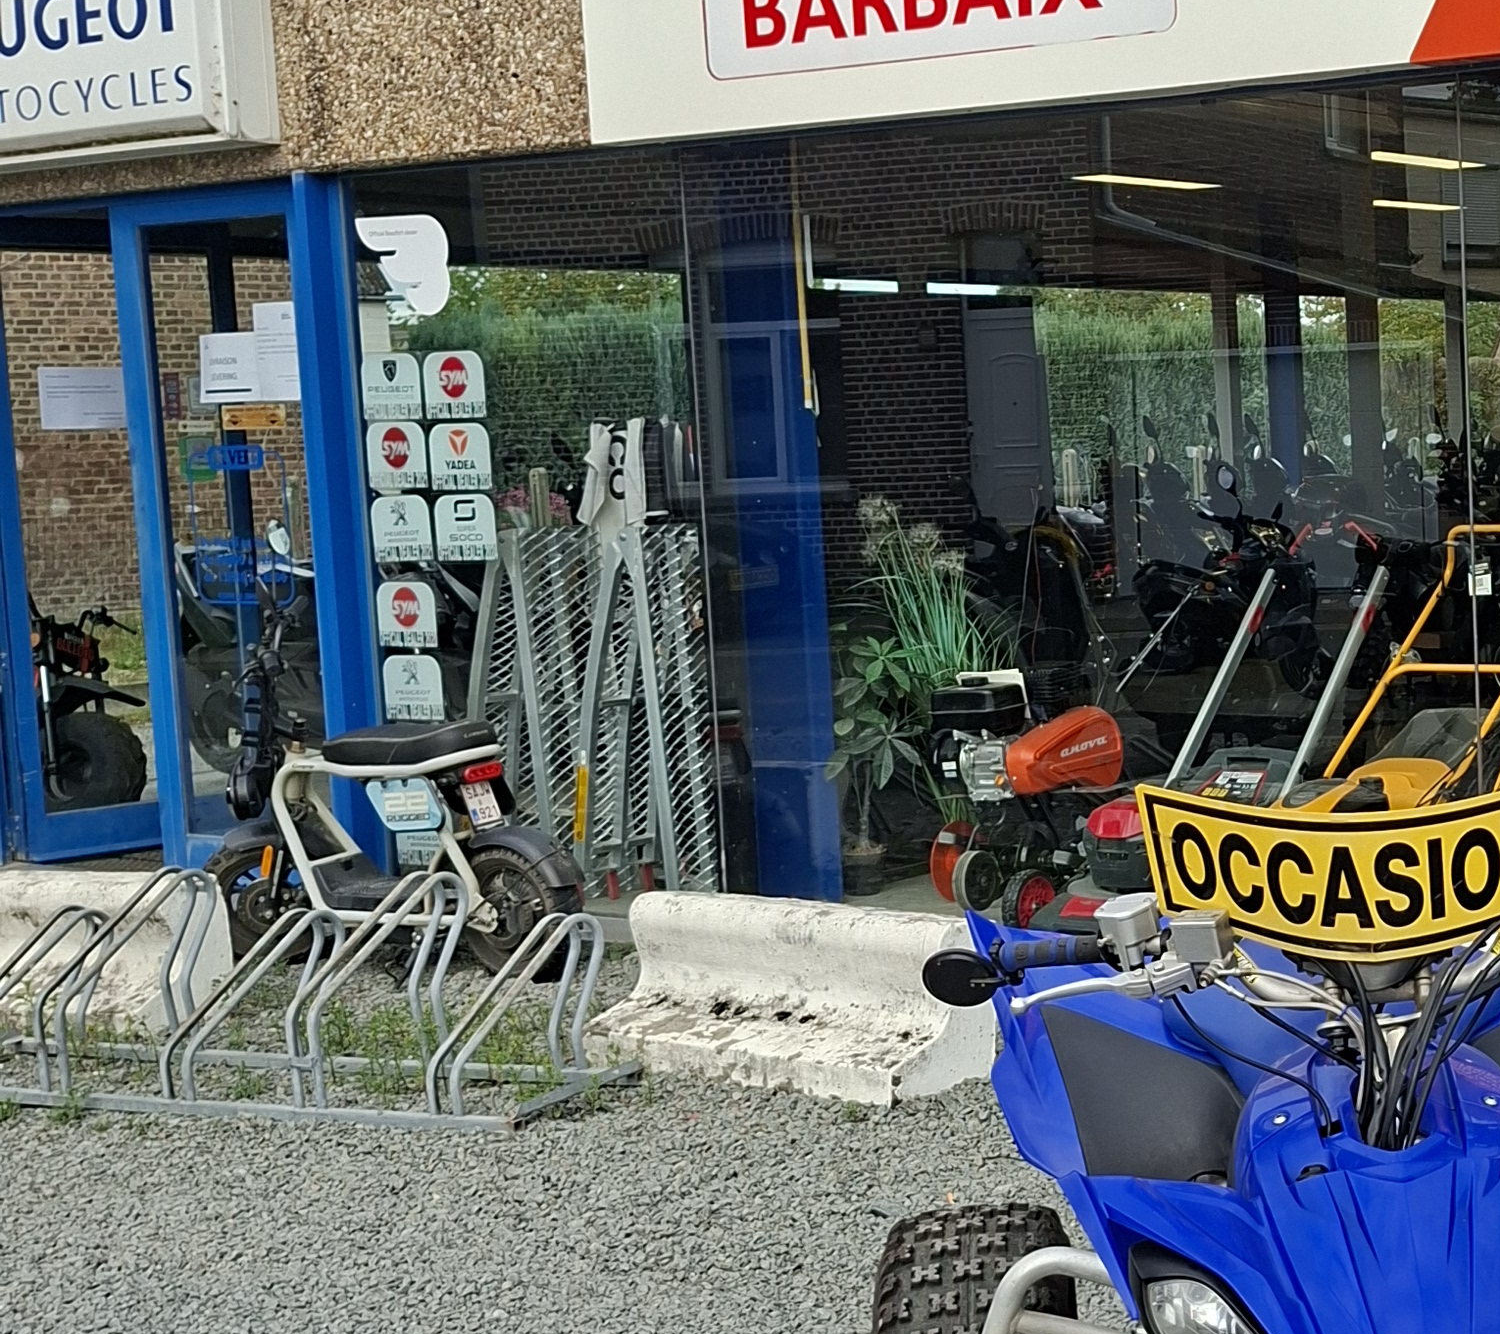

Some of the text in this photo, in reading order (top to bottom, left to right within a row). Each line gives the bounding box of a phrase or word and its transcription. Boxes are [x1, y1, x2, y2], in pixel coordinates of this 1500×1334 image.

[439, 369, 468, 390] SYM
[367, 384, 415, 394] PEUGEOT
[382, 440, 410, 460] SYM
[445, 459, 477, 471] YADEA
[384, 529, 420, 538] PEUGEOT
[449, 533, 484, 542] SOCO
[392, 599, 420, 619] SYM
[386, 813, 431, 823] RUGGED
[407, 834, 439, 842] PEUGEO
